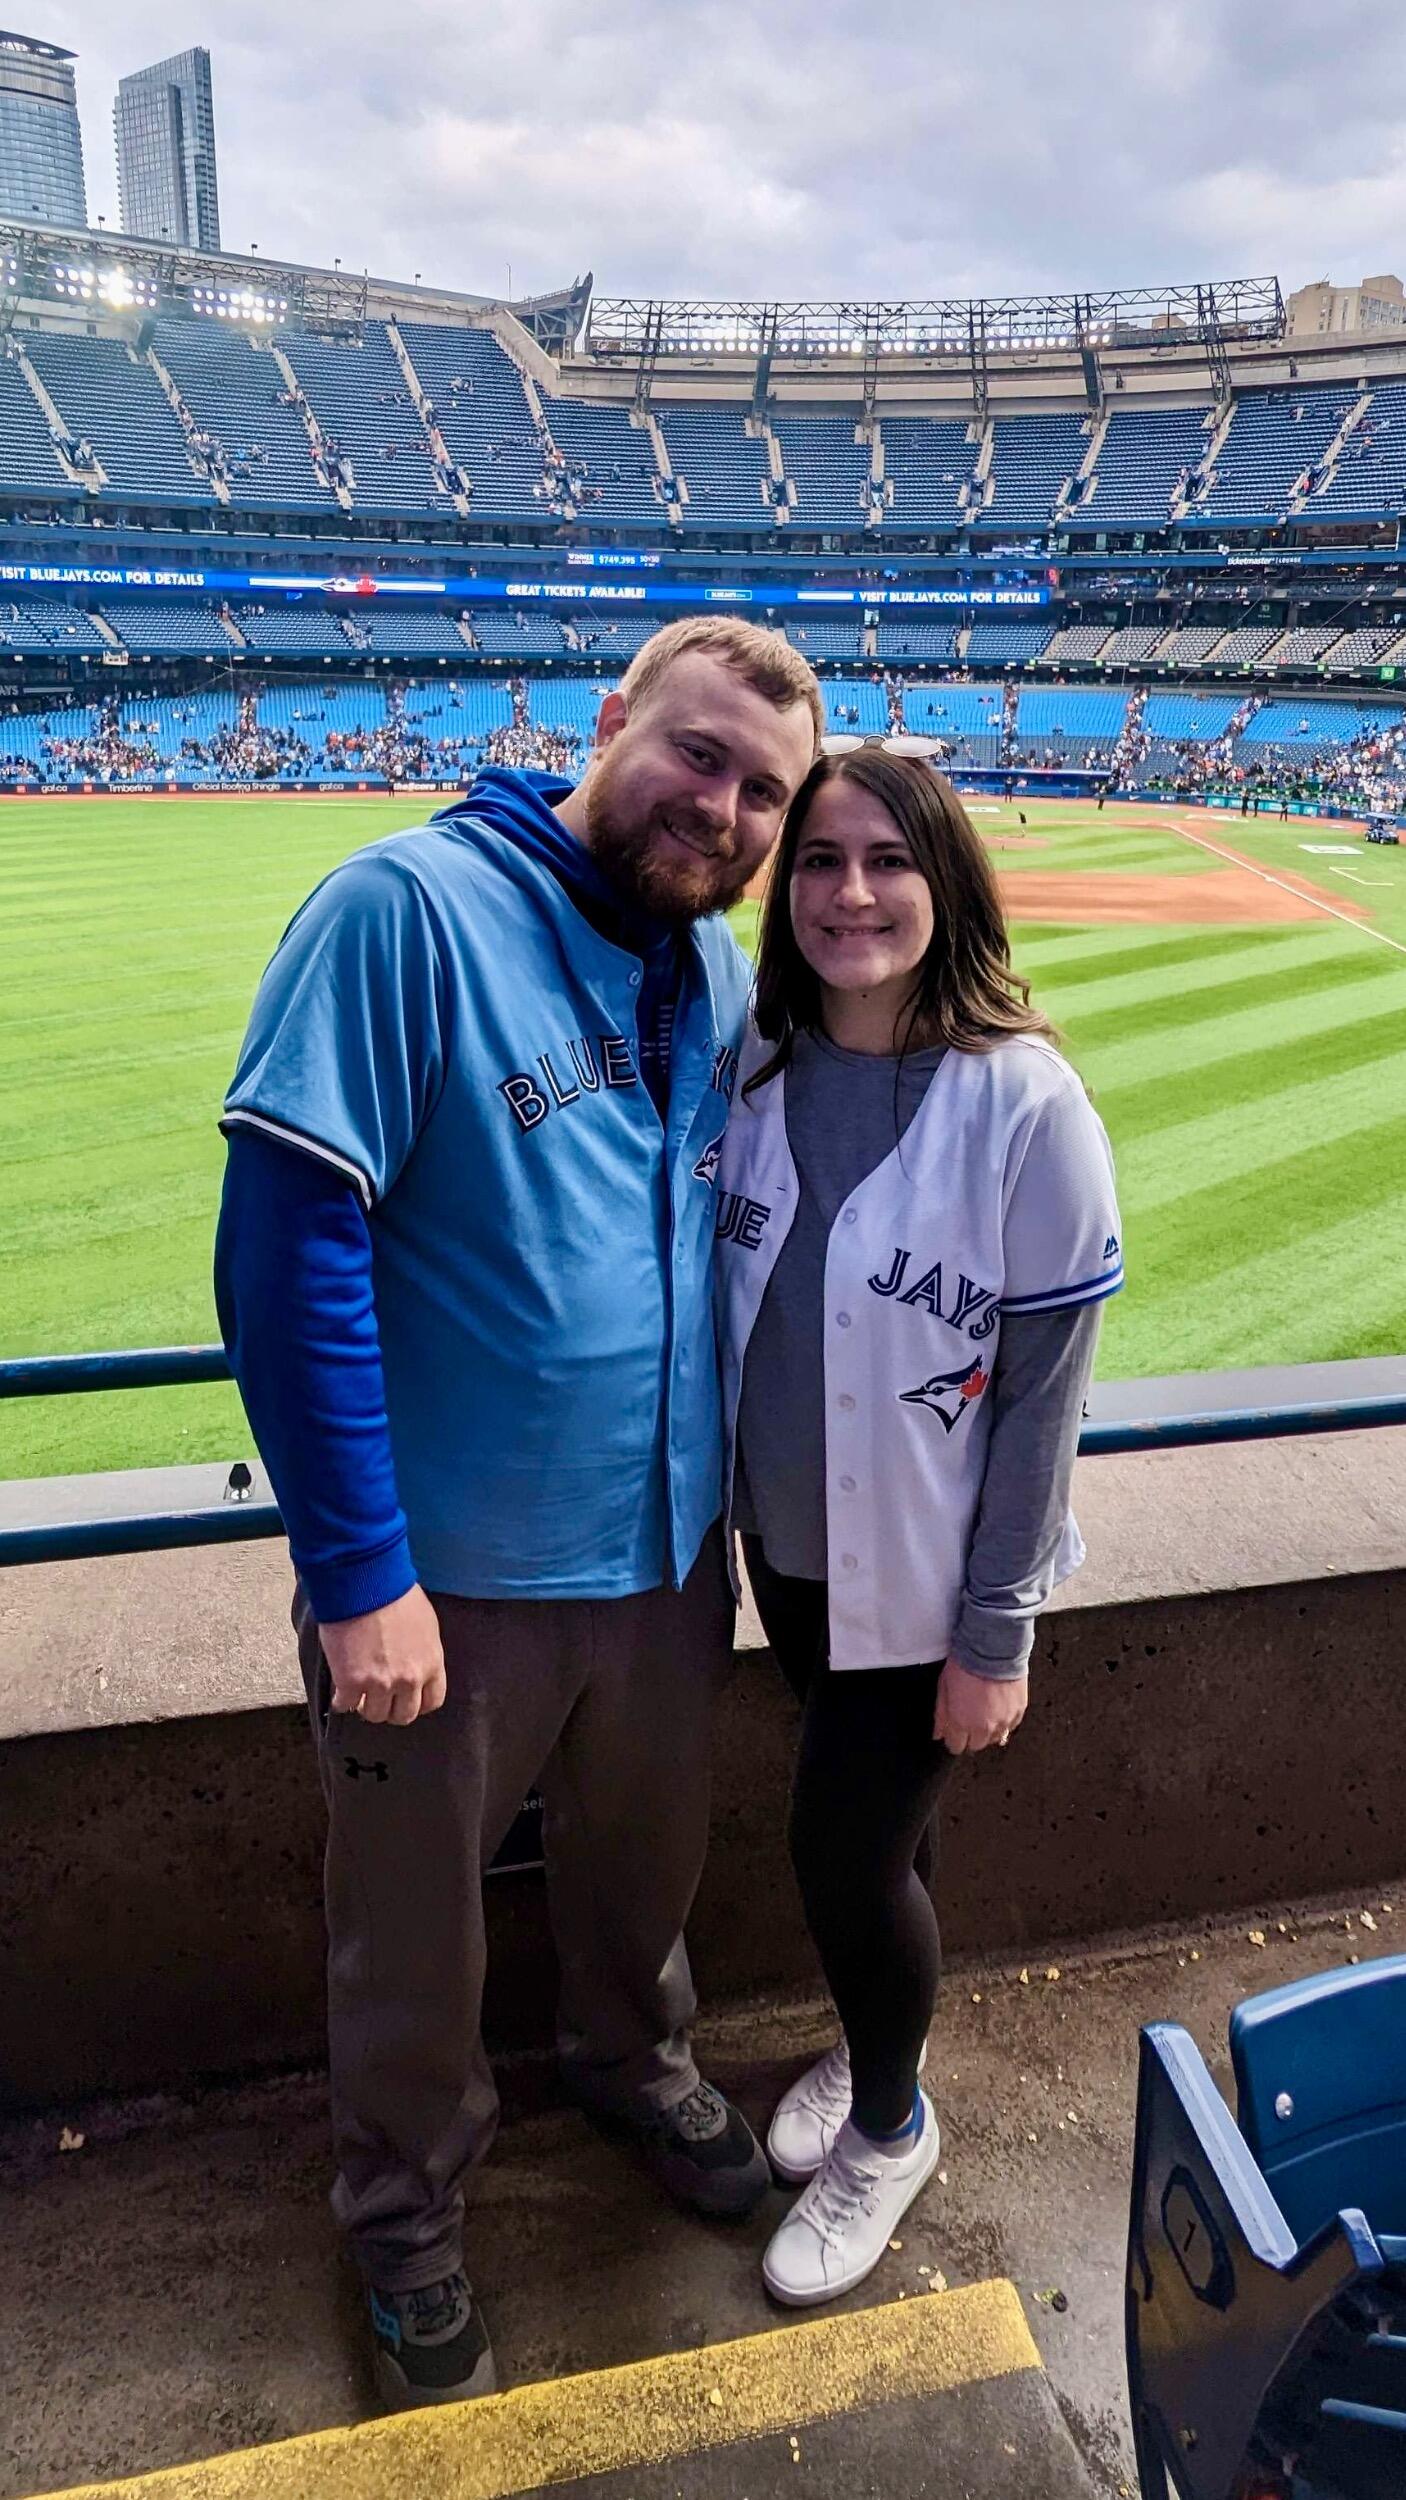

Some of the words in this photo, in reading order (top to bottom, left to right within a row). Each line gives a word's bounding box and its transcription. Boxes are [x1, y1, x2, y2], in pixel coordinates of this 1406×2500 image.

[29, 567, 123, 584] BLUEJAYS.COM
[126, 570, 150, 585] FOR
[155, 572, 205, 586] DETAILS
[505, 584, 541, 596] GREAT
[543, 585, 586, 597] TICKETS
[588, 586, 646, 599] AVAILABLE!
[860, 592, 887, 603] VISIT
[889, 591, 968, 604] BLUEJAYS.COM
[970, 592, 992, 604] FOR
[995, 592, 1041, 604] DETAILS
[108, 783, 153, 793] Timberline
[192, 783, 220, 791] Official
[221, 783, 250, 792] Roofing
[252, 783, 280, 792] Shingle
[441, 782, 458, 791] BET
[497, 1034, 638, 1137] BLUE
[867, 1247, 1001, 1341] JAYS
